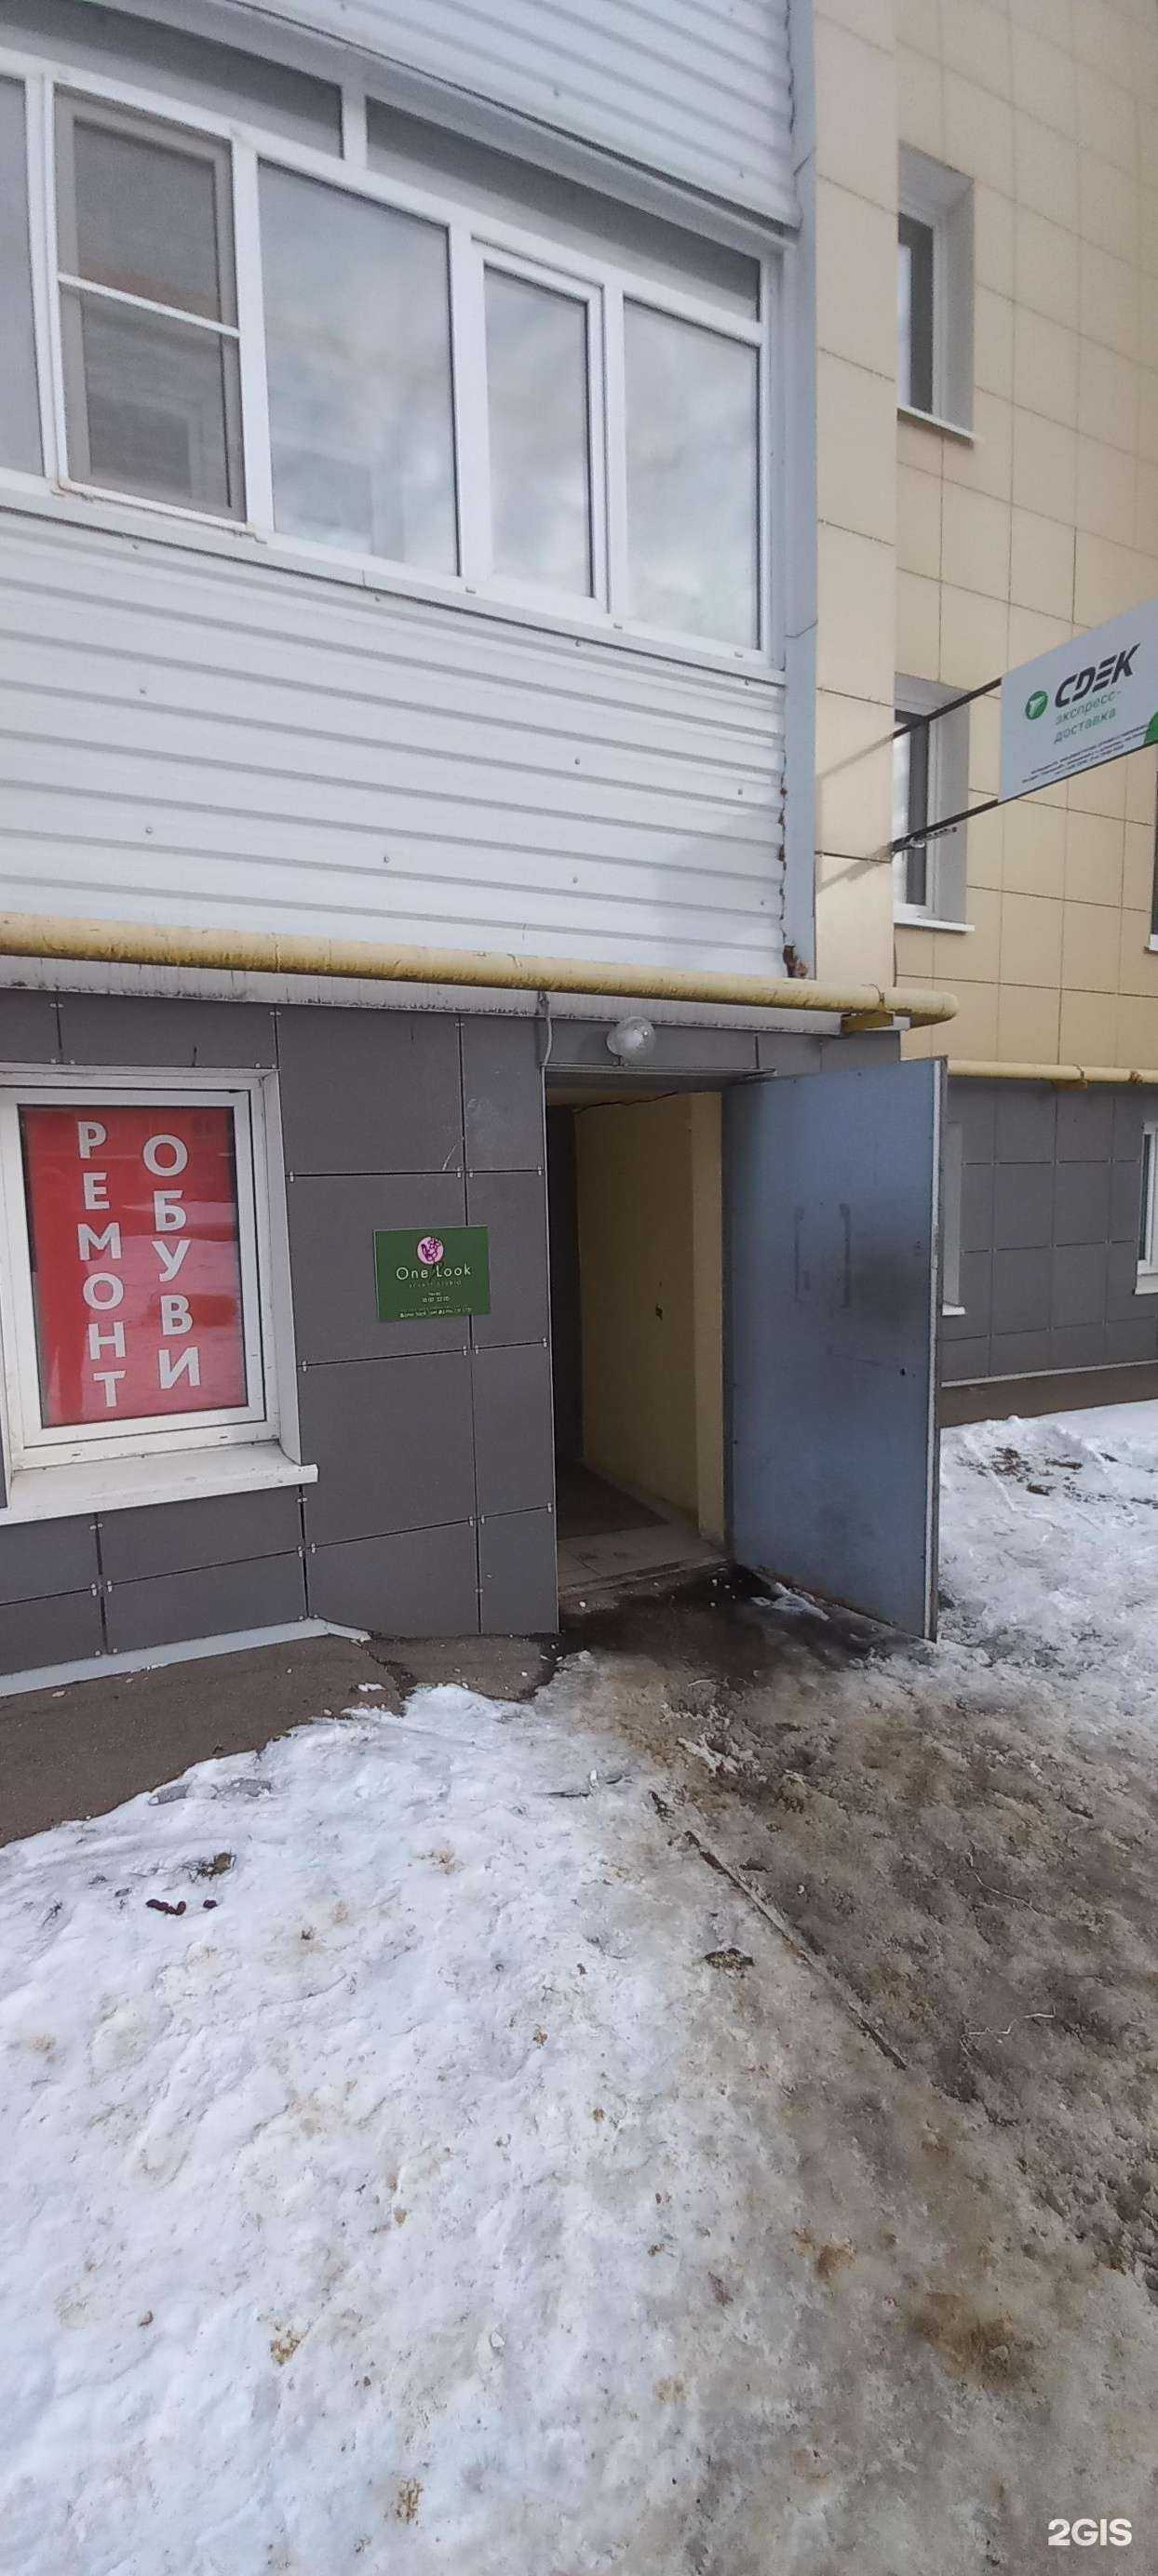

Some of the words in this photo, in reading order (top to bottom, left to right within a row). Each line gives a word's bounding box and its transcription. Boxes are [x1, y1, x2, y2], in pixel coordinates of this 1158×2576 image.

[1055, 642, 1140, 707] CDEK
[77, 1120, 126, 1407] РЕМОНТ
[142, 1134, 200, 1389] ОБУВИ
[396, 1267, 428, 1280] One
[436, 1263, 472, 1277] Look
